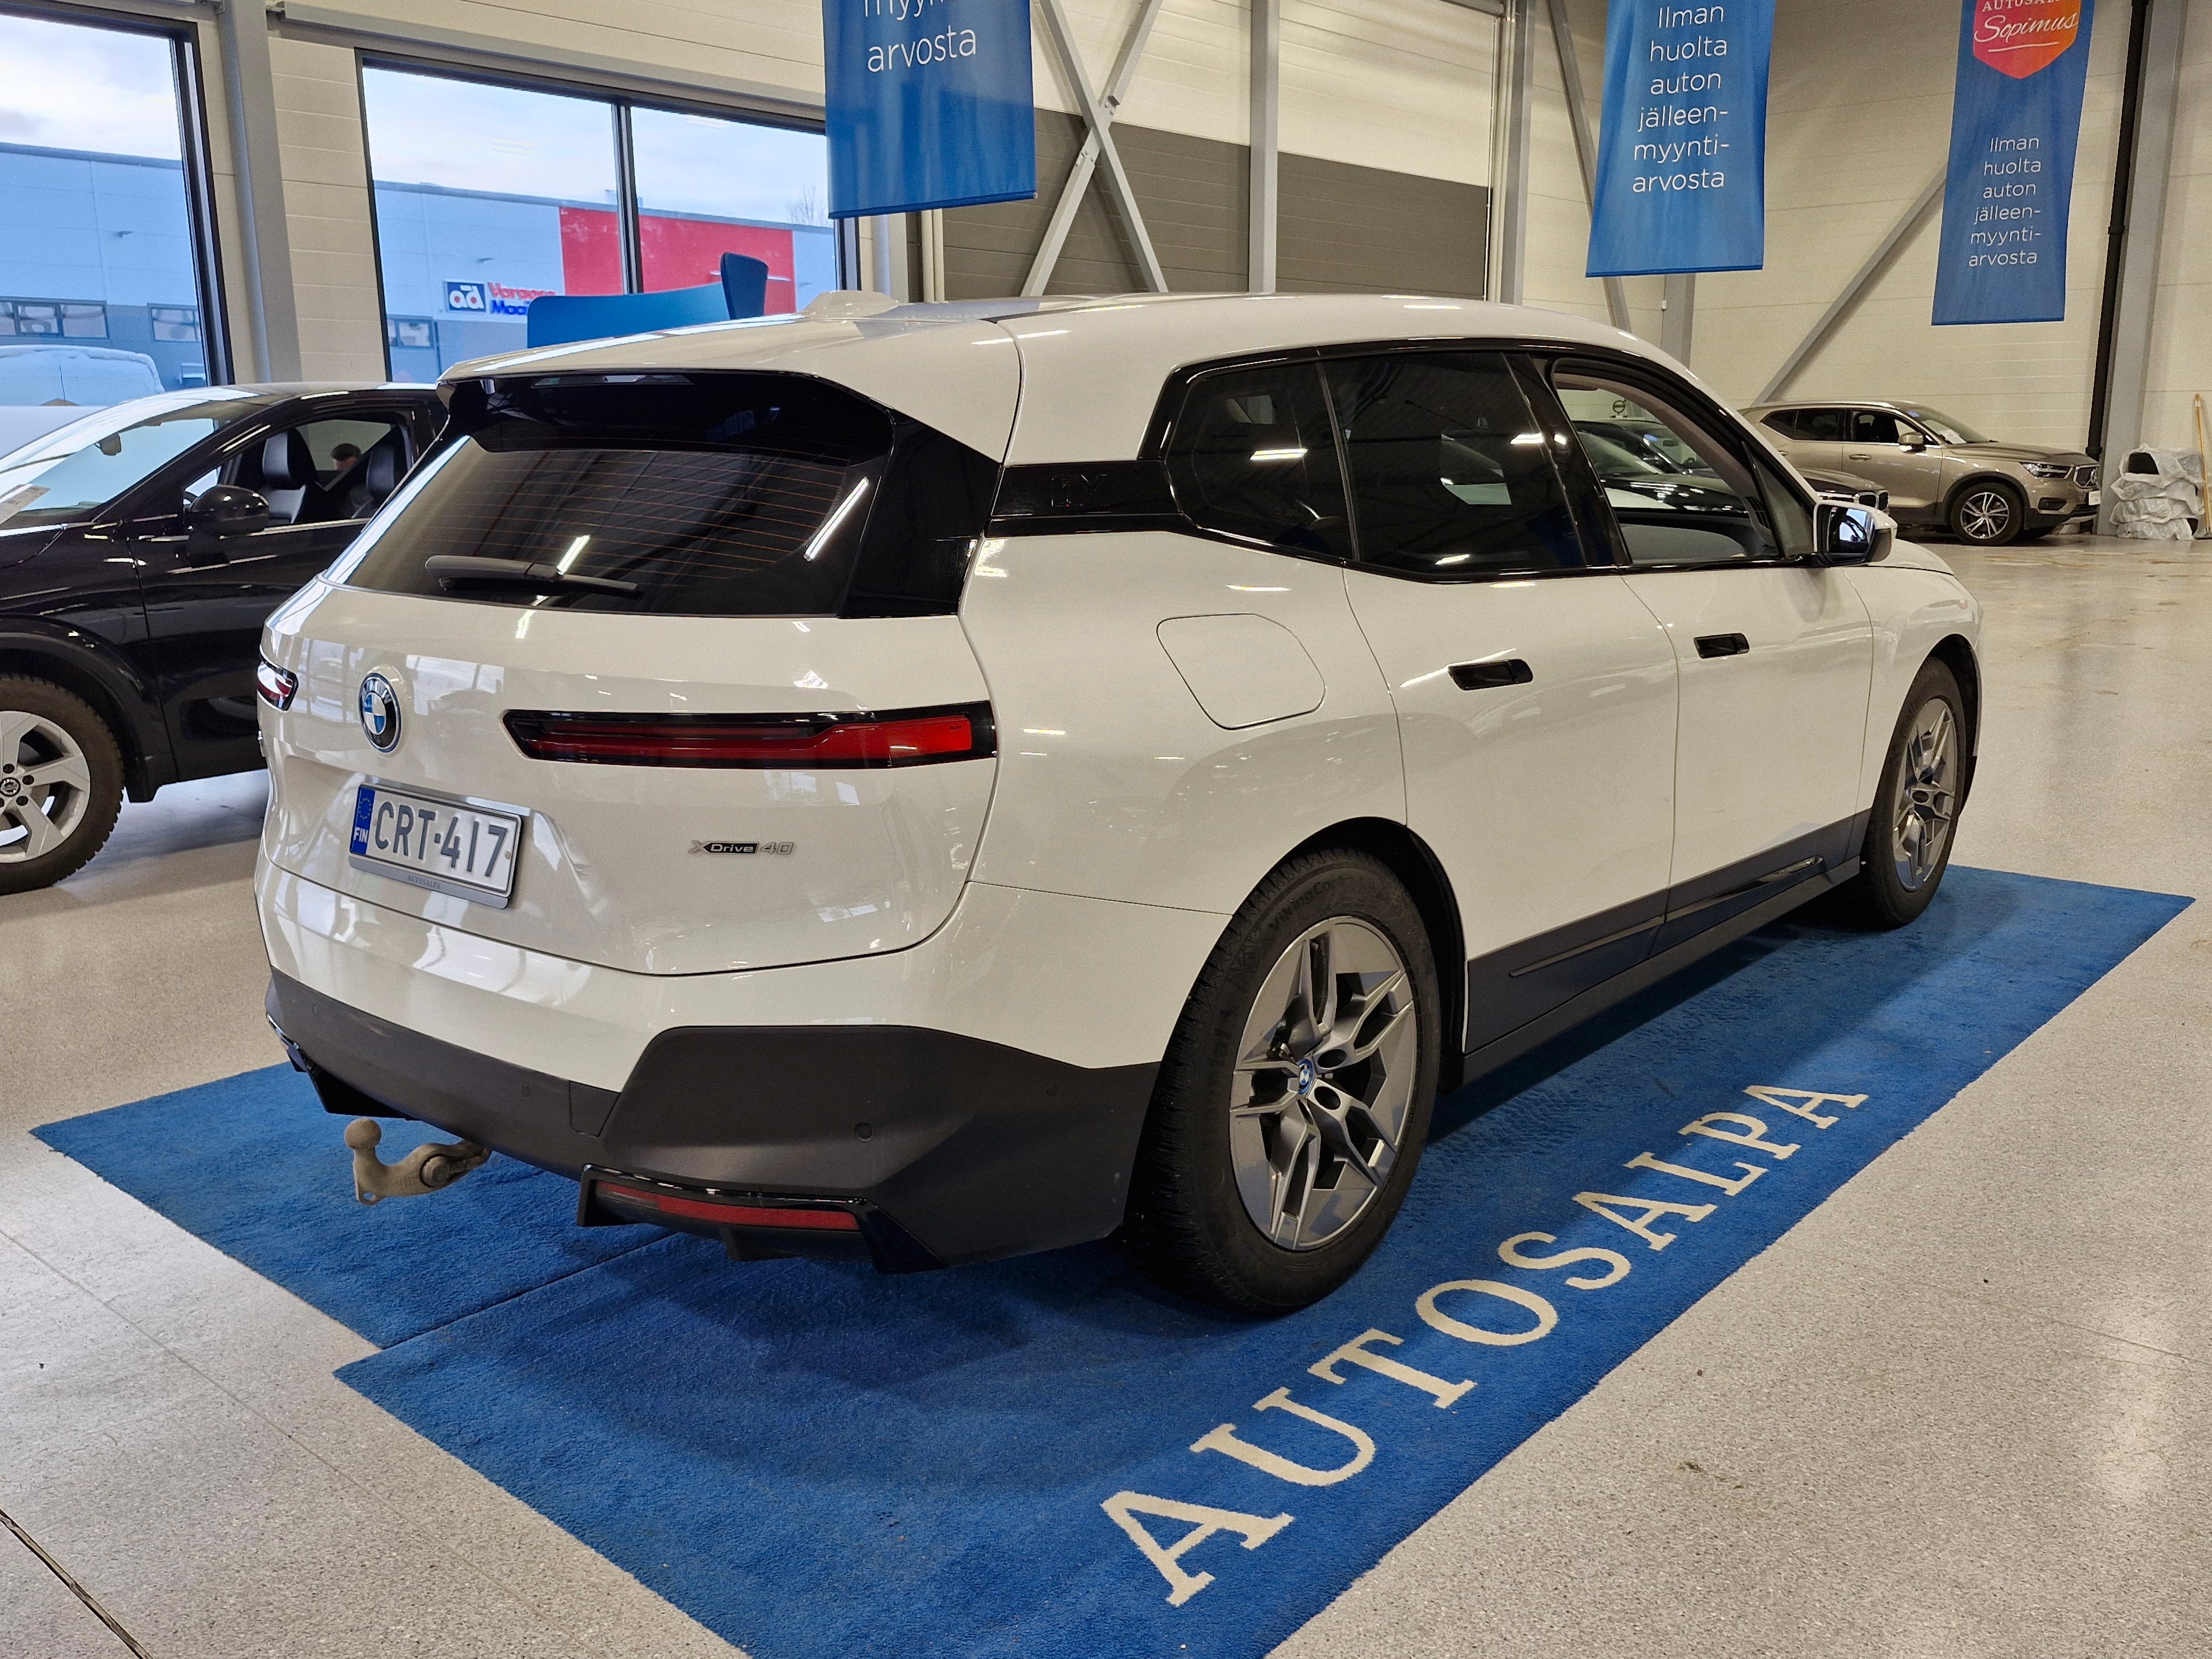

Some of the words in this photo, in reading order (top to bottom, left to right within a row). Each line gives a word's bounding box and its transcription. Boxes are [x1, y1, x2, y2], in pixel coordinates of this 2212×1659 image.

[1658, 4, 1724, 28] Ilman
[1974, 12, 2078, 43] Sopimus
[867, 25, 977, 72] arvosta
[1650, 35, 1728, 62] huolta
[1650, 72, 1721, 95] auton
[1636, 105, 1728, 132] jälleen-
[1633, 133, 1730, 164] myynti-
[1990, 137, 2039, 153] Ilman
[1983, 157, 2042, 176] huolta
[1632, 168, 1725, 193] arvosta
[1983, 182, 2037, 199] auton
[1973, 205, 2041, 225] jälleen-
[1970, 226, 2042, 247] myynti-
[1968, 249, 2038, 267] arvosta
[354, 827, 369, 843] FIN
[761, 841, 794, 855] 40
[408, 875, 441, 890] AUTOSALPA
[1102, 1084, 1870, 1606] AUTOSALPA
